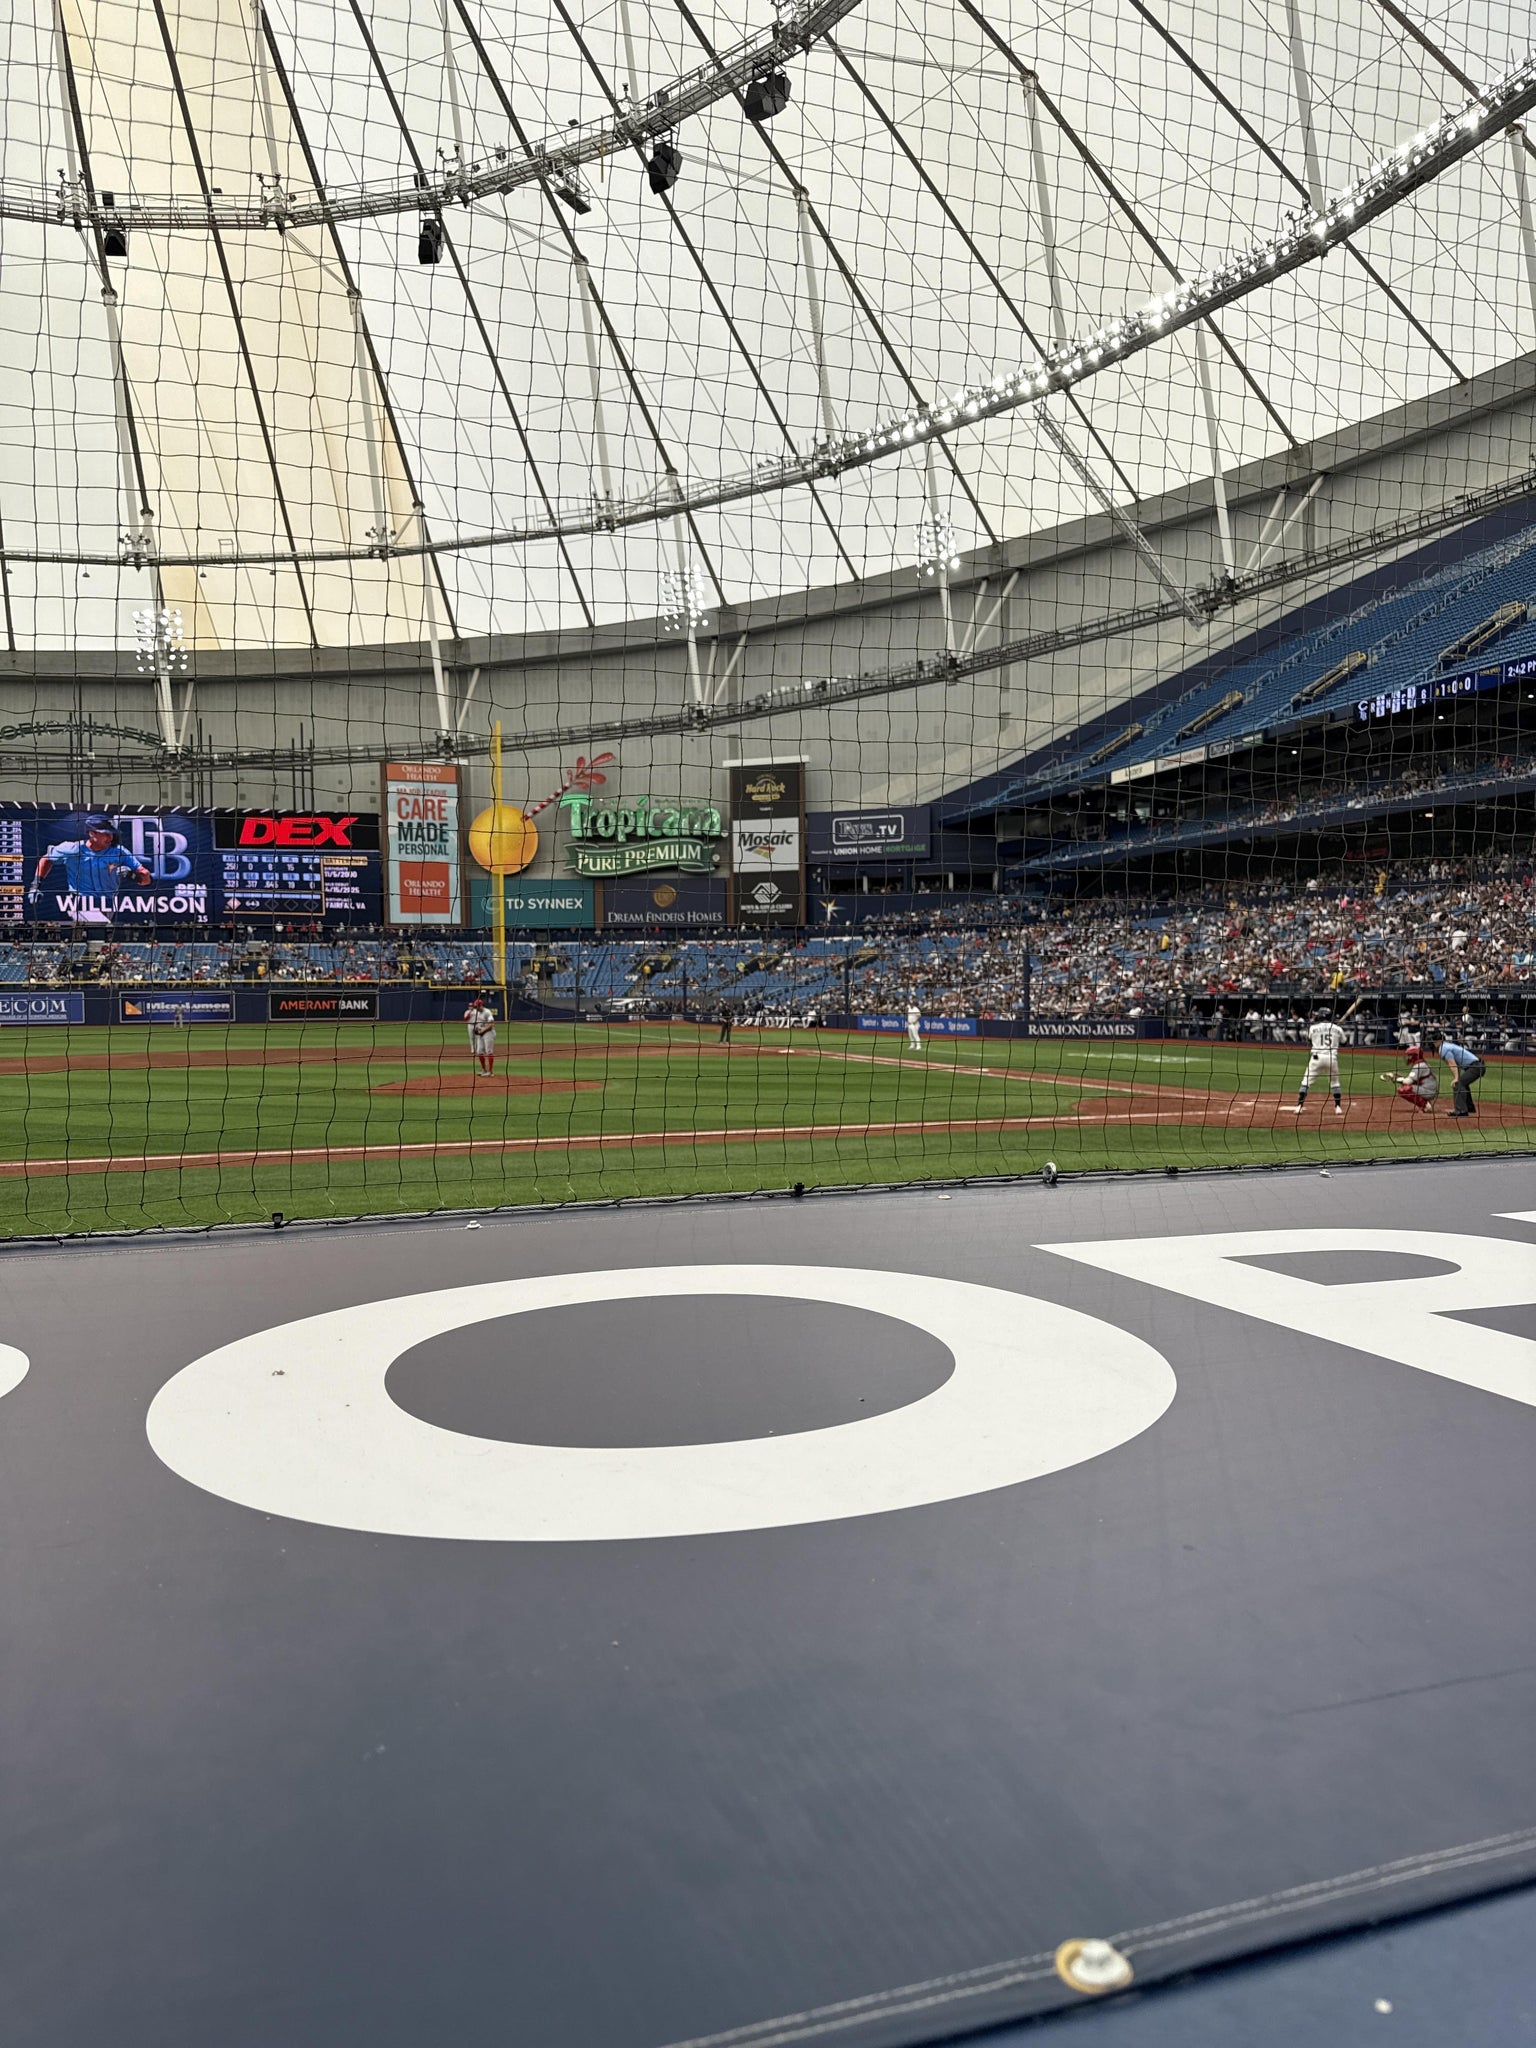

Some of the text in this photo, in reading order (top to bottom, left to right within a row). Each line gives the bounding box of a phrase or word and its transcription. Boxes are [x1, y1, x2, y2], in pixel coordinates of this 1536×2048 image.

[1508, 662, 1526, 677] 2:42
[1441, 683, 1446, 697] 1
[1464, 676, 1472, 691] 0
[397, 797, 448, 821] CARE
[559, 793, 722, 842] Tropicana
[239, 816, 360, 846] DEX
[398, 822, 449, 843] MADE
[738, 830, 793, 847] Mosaic
[398, 843, 449, 856] PERSONAL
[577, 844, 702, 871] PURE PREMIUM
[833, 847, 858, 856] UNION
[860, 846, 883, 854] HOME
[404, 879, 445, 889] ORLANDO
[56, 895, 206, 914] WILLIAMSON
[506, 898, 583, 909] TD SYNNEX
[608, 912, 723, 923] DREAM FINDERS HOMES
[279, 1000, 369, 1010] AMERANT BANK
[1028, 1024, 1135, 1036] RAYMOND JAMES
[1320, 1034, 1332, 1046] 15
[0, 1211, 1536, 1542] OR
